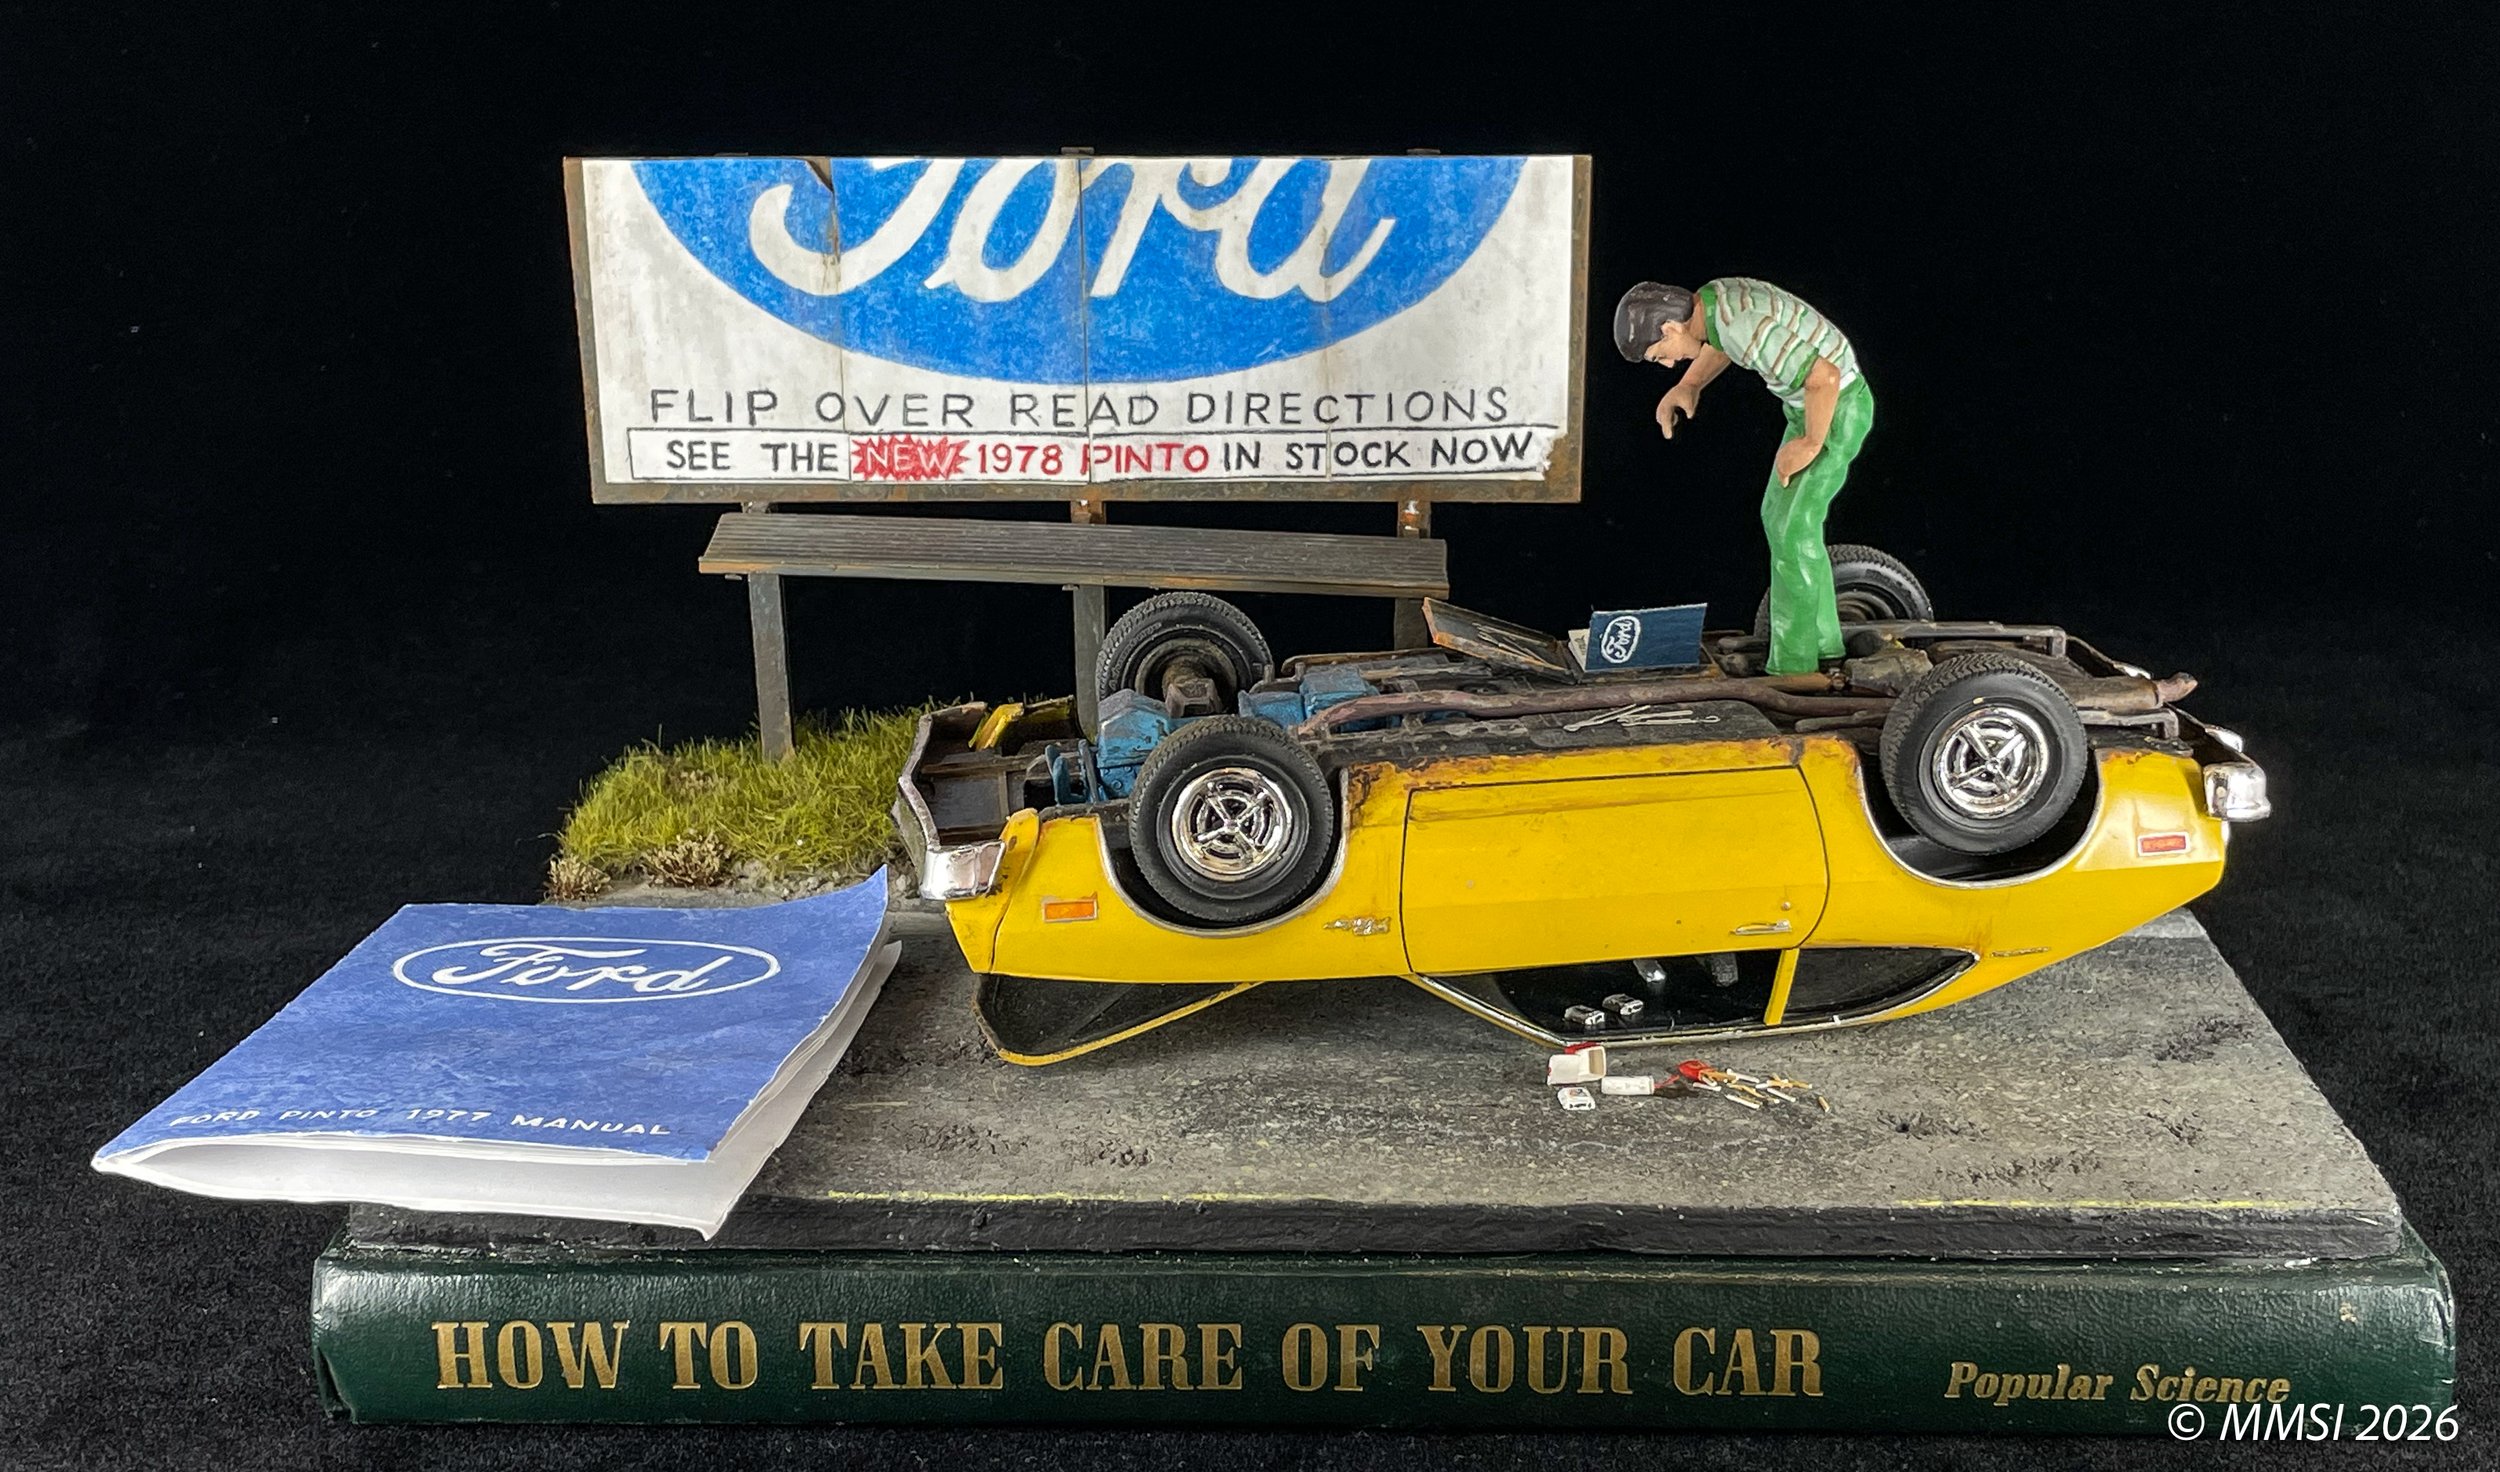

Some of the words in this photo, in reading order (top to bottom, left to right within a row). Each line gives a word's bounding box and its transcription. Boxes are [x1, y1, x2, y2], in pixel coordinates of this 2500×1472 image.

[650, 389, 778, 426] FLIP
[815, 391, 973, 428] OVER
[1010, 392, 1159, 427] READ
[1186, 386, 1508, 425] DIRECTIONS
[666, 440, 731, 471] SEE
[760, 441, 839, 472] THE
[863, 446, 954, 477] NEW
[978, 443, 1064, 477] 1978
[1080, 443, 1209, 476] PINTO
[1223, 441, 1261, 471] IN
[1286, 440, 1410, 471] STOCK
[1430, 431, 1533, 468] NOW
[432, 944, 732, 992] Ford
[170, 1110, 260, 1127] FORD
[284, 1109, 380, 1121] PINTO
[407, 1108, 489, 1124] 1977
[510, 1113, 672, 1136] MANUAL
[431, 1319, 630, 1390] HOW
[659, 1320, 758, 1390] TO
[800, 1321, 1003, 1391] TAKE
[1043, 1322, 1243, 1391] CARE
[1280, 1323, 1381, 1392] OF
[1416, 1325, 1633, 1395] YOUR
[1672, 1327, 1824, 1397] CAR
[1944, 1361, 2114, 1406] Popular
[2130, 1363, 2292, 1404] Science
